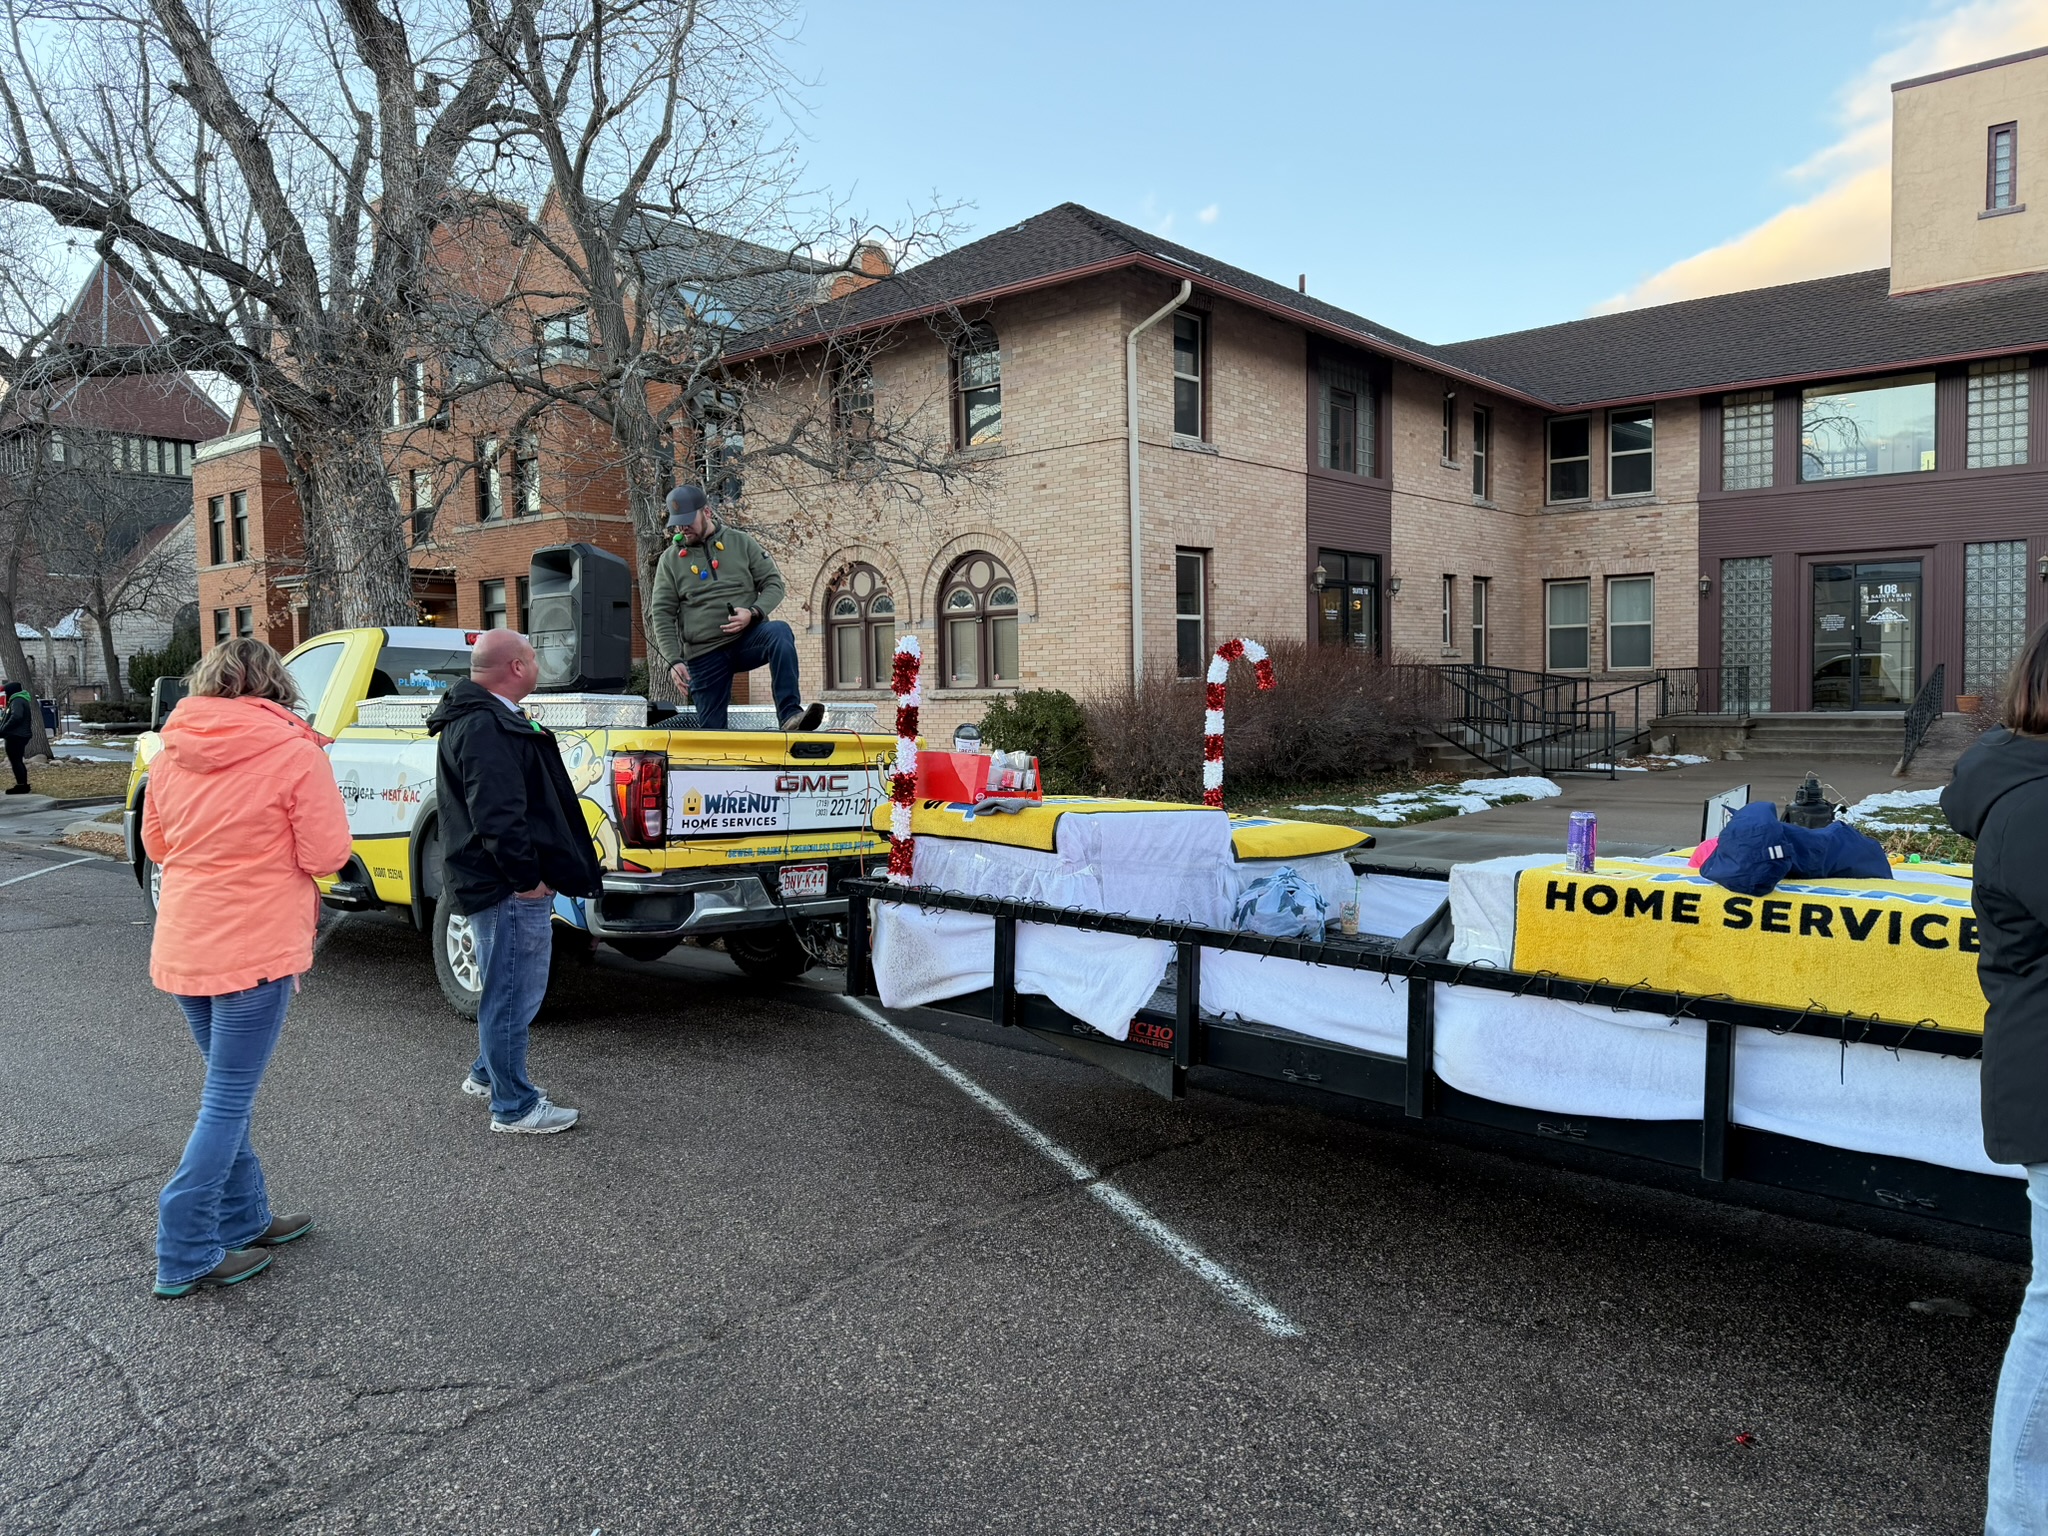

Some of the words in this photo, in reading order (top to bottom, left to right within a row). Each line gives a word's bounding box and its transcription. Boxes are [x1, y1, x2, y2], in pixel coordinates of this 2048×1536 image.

[1352, 587, 1364, 595] SUITE
[1877, 584, 1898, 594] 108
[398, 677, 447, 689] PLUMBING
[775, 774, 849, 793] GMC
[382, 788, 402, 802] HEAT
[402, 789, 409, 803] &
[410, 789, 421, 803] AC
[681, 817, 718, 829] HOME
[722, 816, 777, 827] SERVICES
[1545, 880, 1702, 925] HOME
[1722, 896, 1980, 953] SERVICE
[1130, 1021, 1174, 1040] CHO
[1129, 1036, 1170, 1049] TRAILERS
